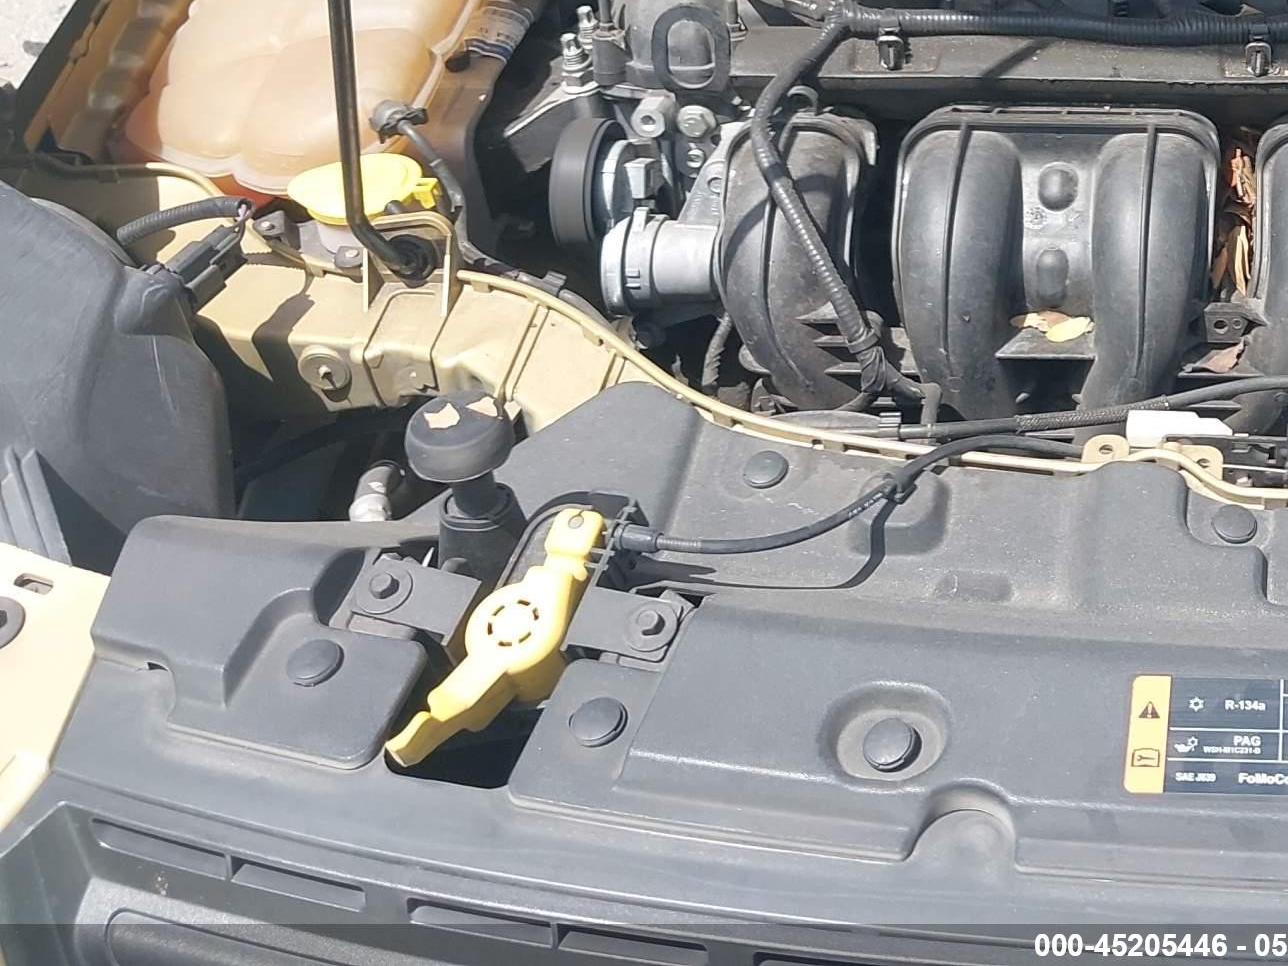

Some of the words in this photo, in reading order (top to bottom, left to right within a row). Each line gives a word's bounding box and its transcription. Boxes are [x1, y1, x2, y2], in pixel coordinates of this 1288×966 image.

[1224, 699, 1266, 712] R-134a
[1233, 735, 1262, 747] PAG
[1175, 772, 1195, 782] SAE
